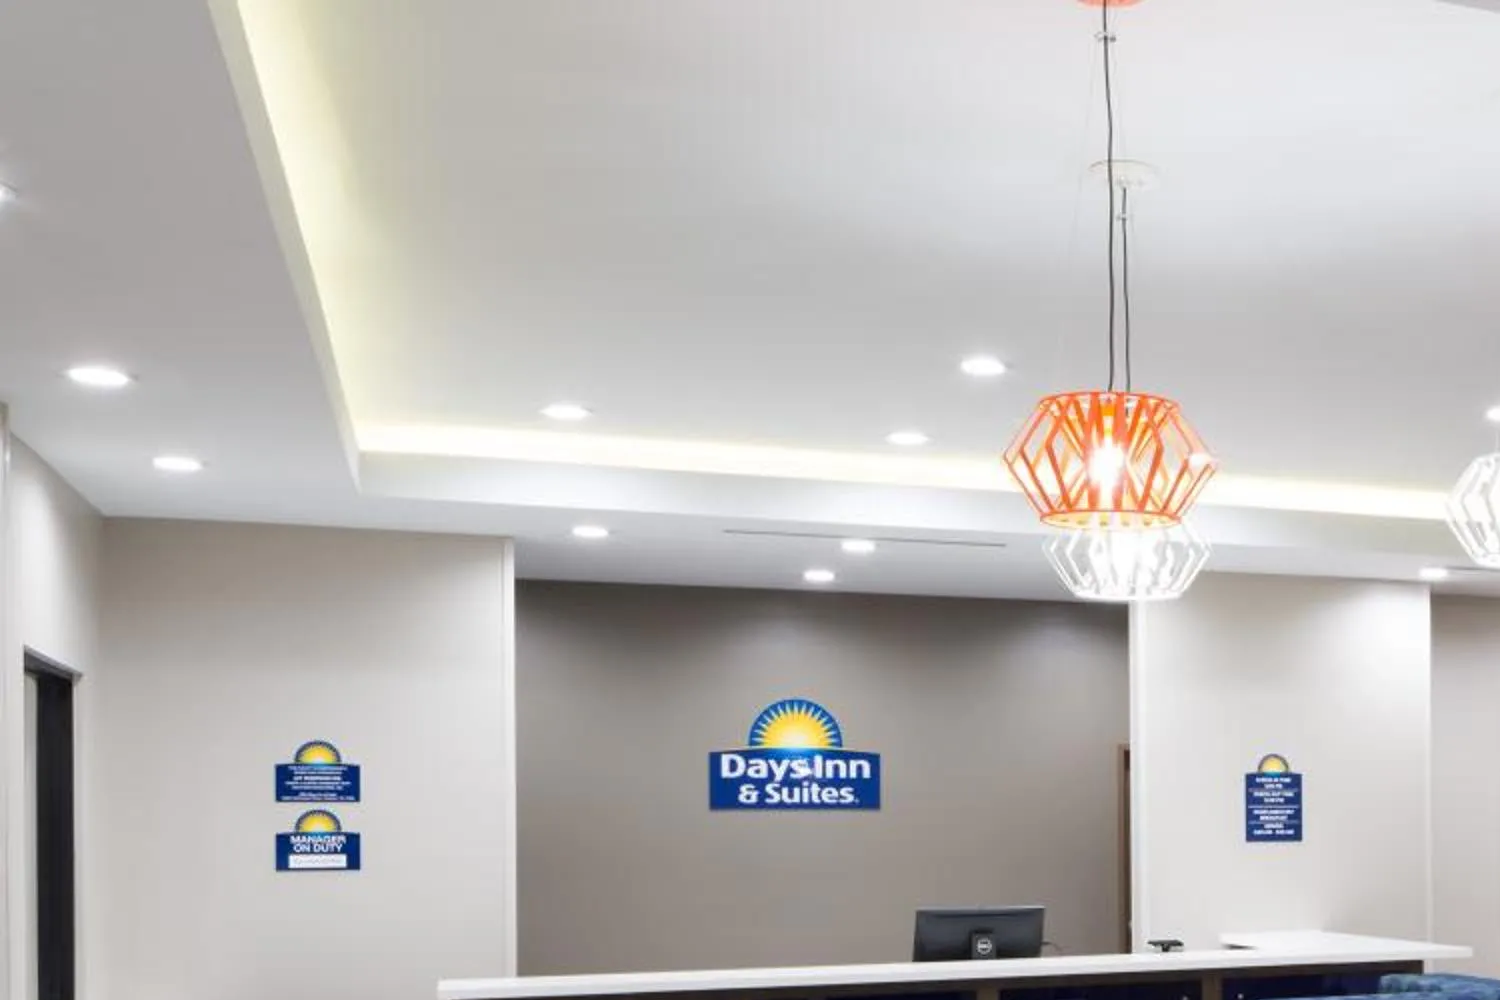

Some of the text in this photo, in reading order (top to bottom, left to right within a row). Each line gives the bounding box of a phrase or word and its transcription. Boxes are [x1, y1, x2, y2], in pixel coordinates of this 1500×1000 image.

[738, 781, 855, 804] & Suites
[290, 835, 347, 845] MANAGER
[293, 843, 343, 853] ON DUTY
